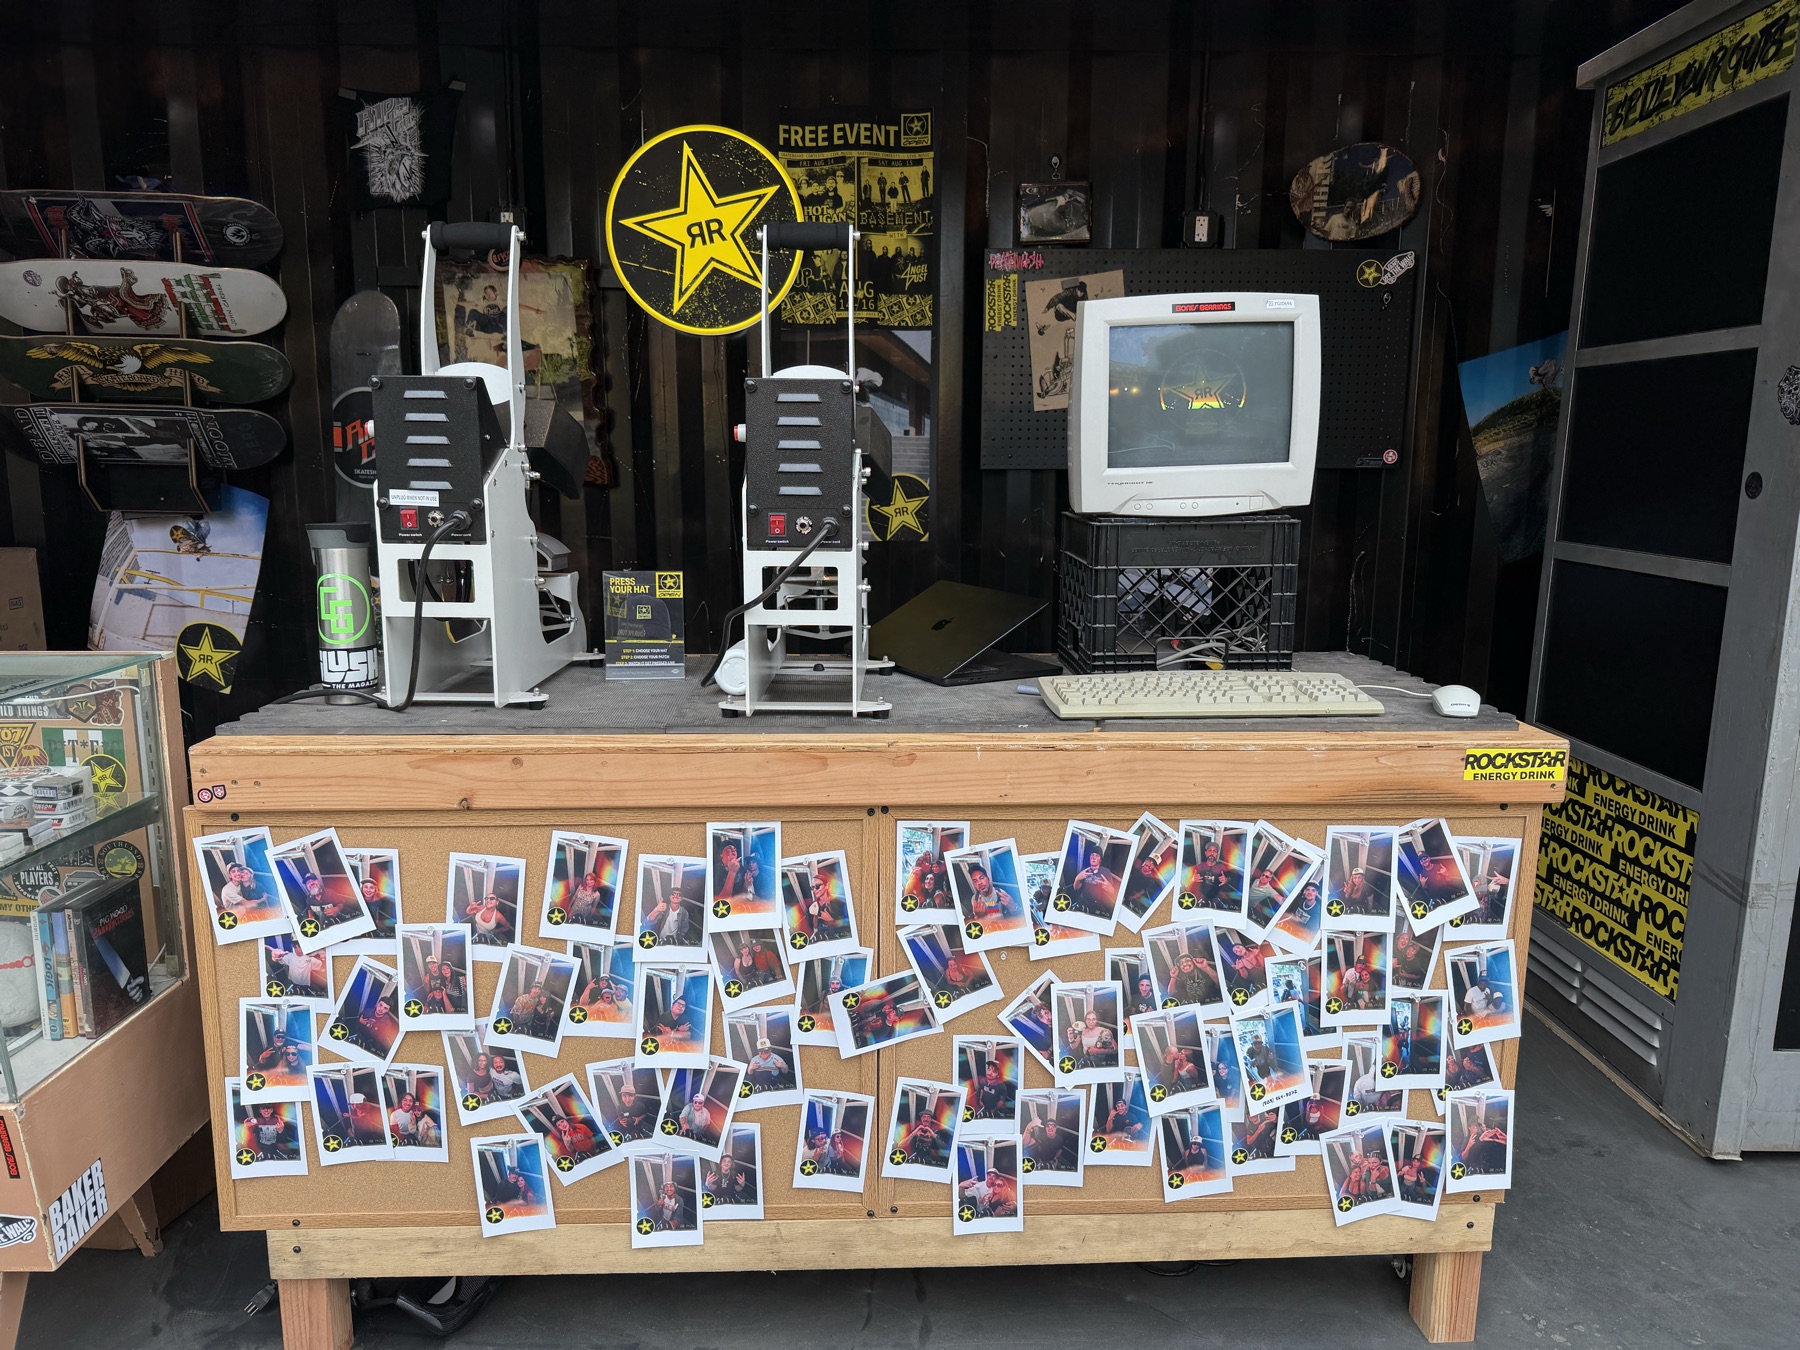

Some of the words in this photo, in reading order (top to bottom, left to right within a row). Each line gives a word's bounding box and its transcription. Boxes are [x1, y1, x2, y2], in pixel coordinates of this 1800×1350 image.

[778, 124, 829, 147] FREE
[833, 122, 899, 147] EVENT
[804, 205, 829, 215] HOT
[860, 210, 931, 225] BASEMENT
[988, 279, 997, 332] ROCKSTAR
[1003, 273, 1012, 327] ROCKSTAR
[1175, 304, 1199, 312] BONES
[1200, 303, 1232, 311] BEARINGS
[97, 374, 166, 385] SKATEBOARDS
[14, 407, 58, 465] DEAD
[201, 411, 238, 469] MOON
[246, 421, 264, 457] ZERO
[610, 577, 636, 586] PRESS
[610, 585, 633, 594] YOUR
[634, 585, 650, 594] HAT
[319, 648, 378, 682] LUSH
[0, 705, 13, 716] ILD
[17, 705, 49, 717] THINGS
[0, 728, 23, 742] 07
[1464, 751, 1567, 771] ROCKSTAR
[1473, 772, 1519, 781] ENERGY
[1520, 770, 1556, 780] DRINK
[1594, 792, 1637, 823] ENERGY
[1638, 811, 1677, 841] DRINK
[1570, 832, 1604, 857] DRINK
[1612, 823, 1694, 886] ROCKST
[20, 871, 54, 886] PLAYERS
[1548, 841, 1642, 913] ROCKSTAR
[1619, 859, 1667, 896] ENERGY
[1667, 884, 1688, 907] DRI
[0, 903, 14, 912] MY
[1553, 873, 1595, 907] ENERGY
[1594, 898, 1629, 928] DRINK
[1570, 903, 1672, 988] ROCKSTAR
[44, 956, 54, 989] LOGIC
[7, 1152, 18, 1176] BONES
[48, 1159, 104, 1235] BAKER
[53, 1187, 109, 1264] BAKER
